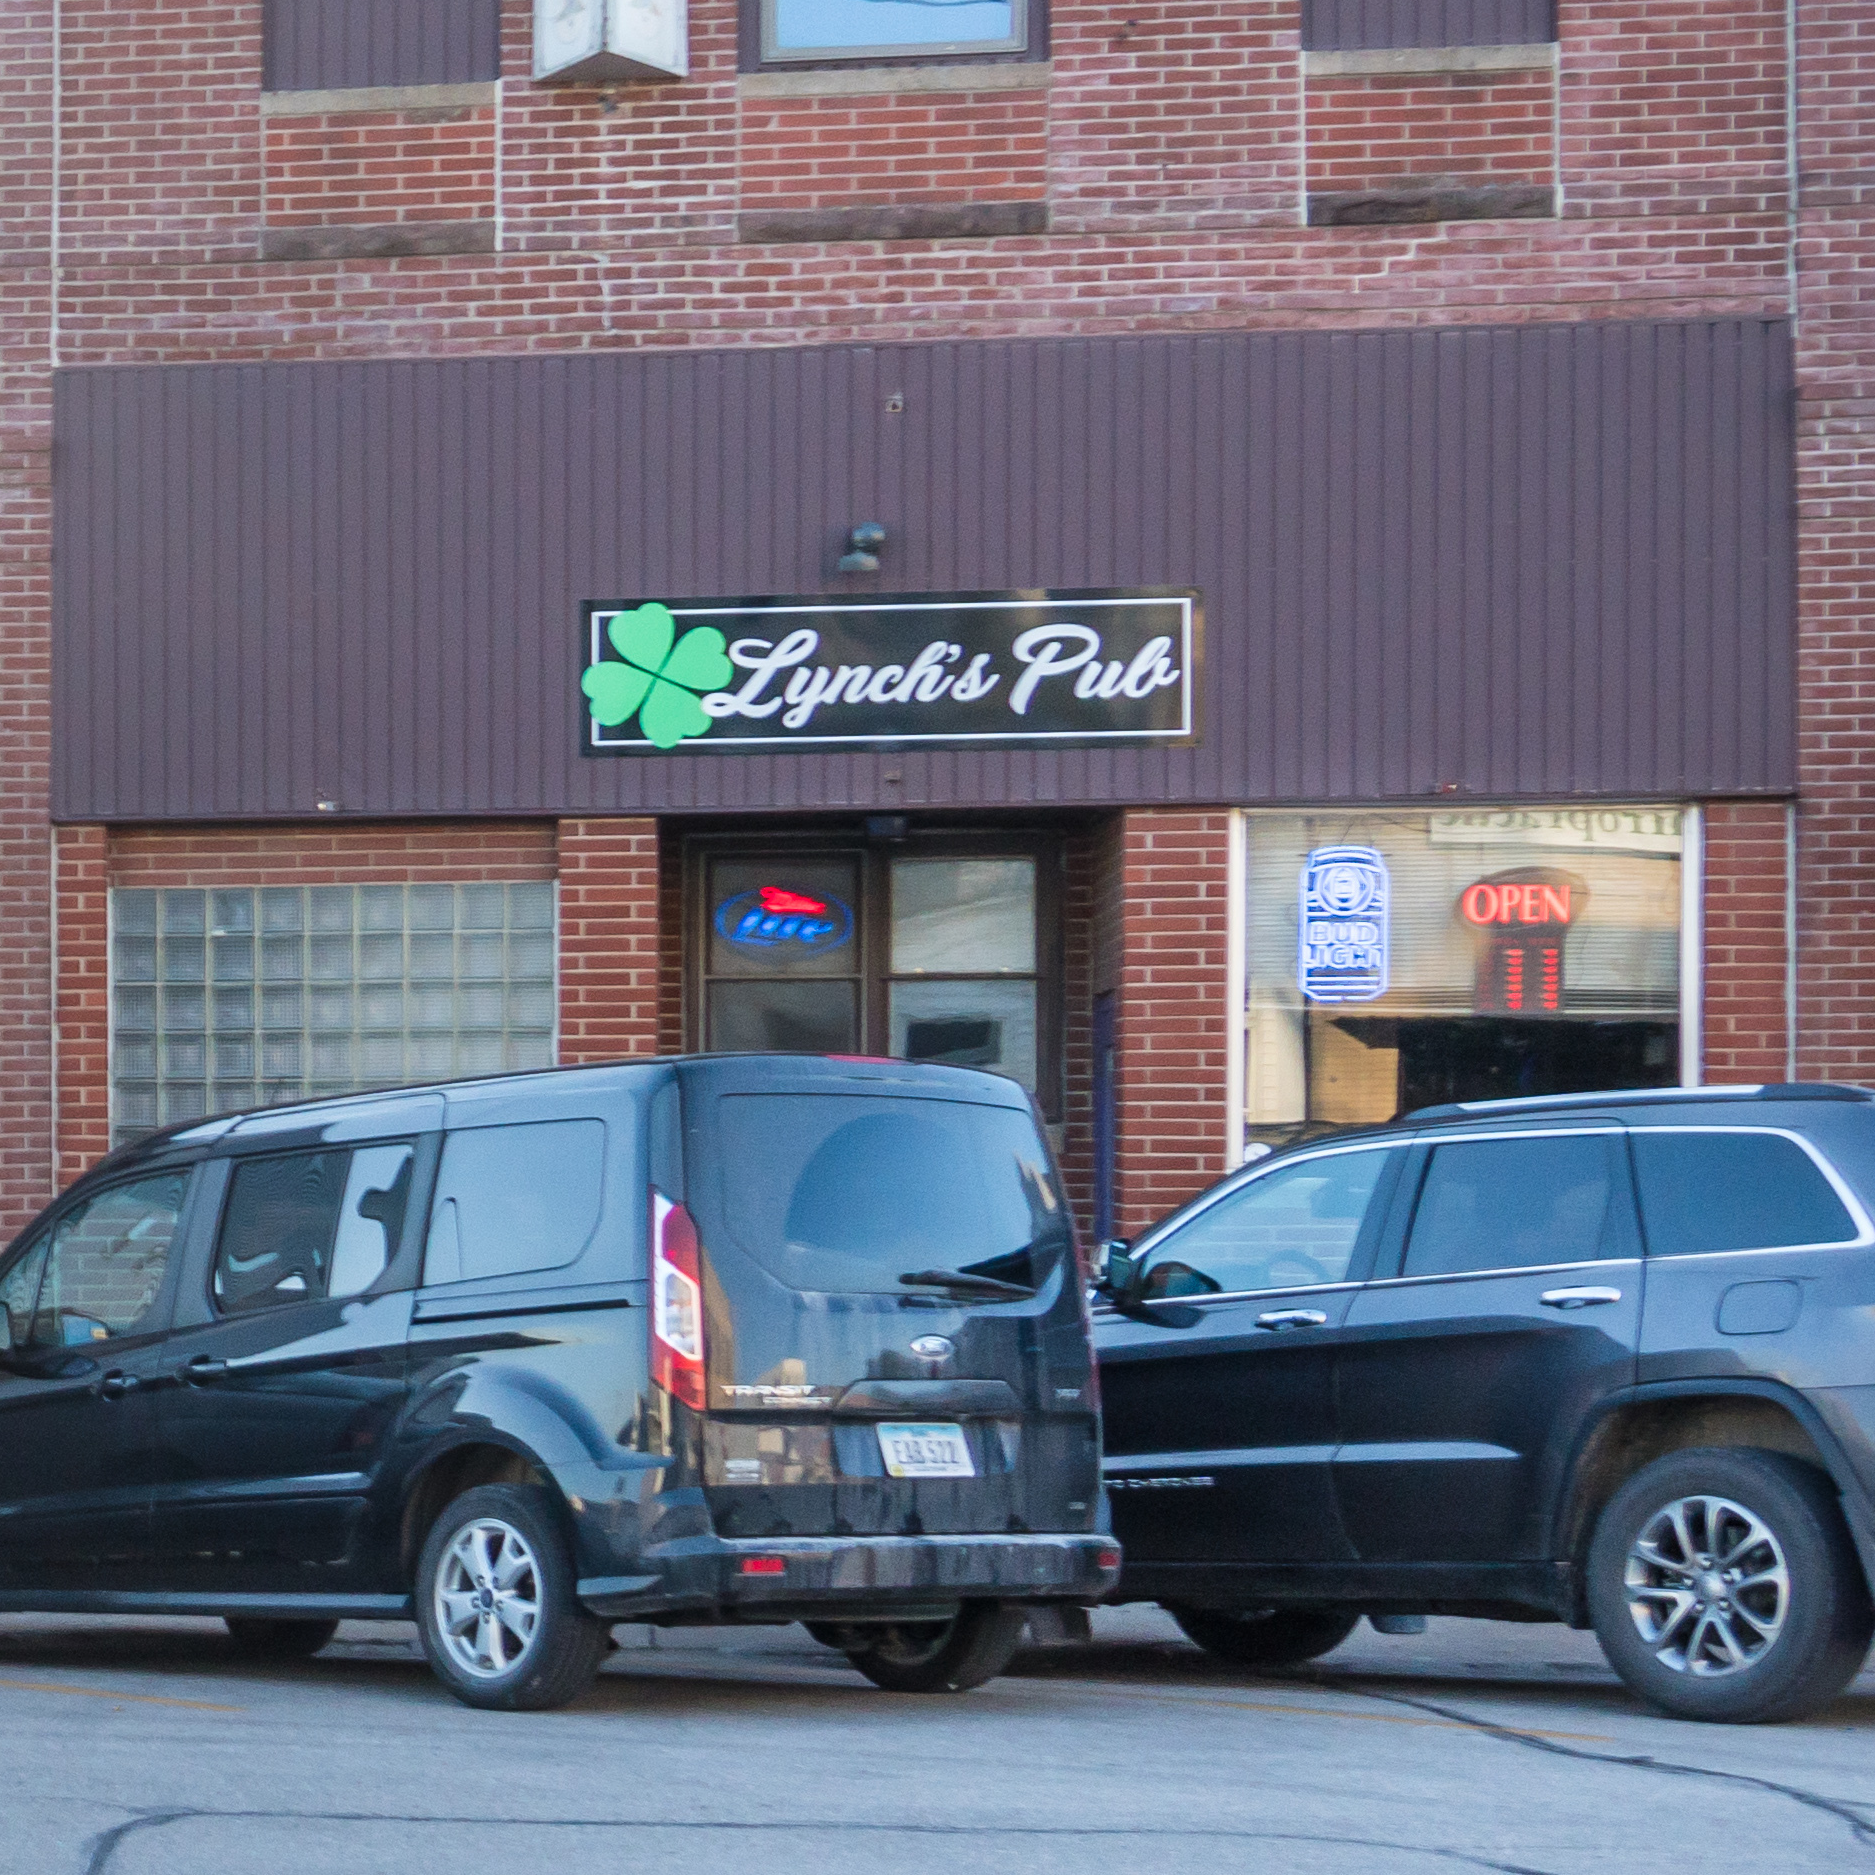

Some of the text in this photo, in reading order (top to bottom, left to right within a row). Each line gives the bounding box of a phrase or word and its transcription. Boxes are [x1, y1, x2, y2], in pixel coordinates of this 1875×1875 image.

[700, 623, 1180, 729] Lynch's Pub
[1462, 884, 1570, 924] OPEN
[1308, 922, 1379, 945] BUD
[1302, 944, 1384, 969] LIGHT
